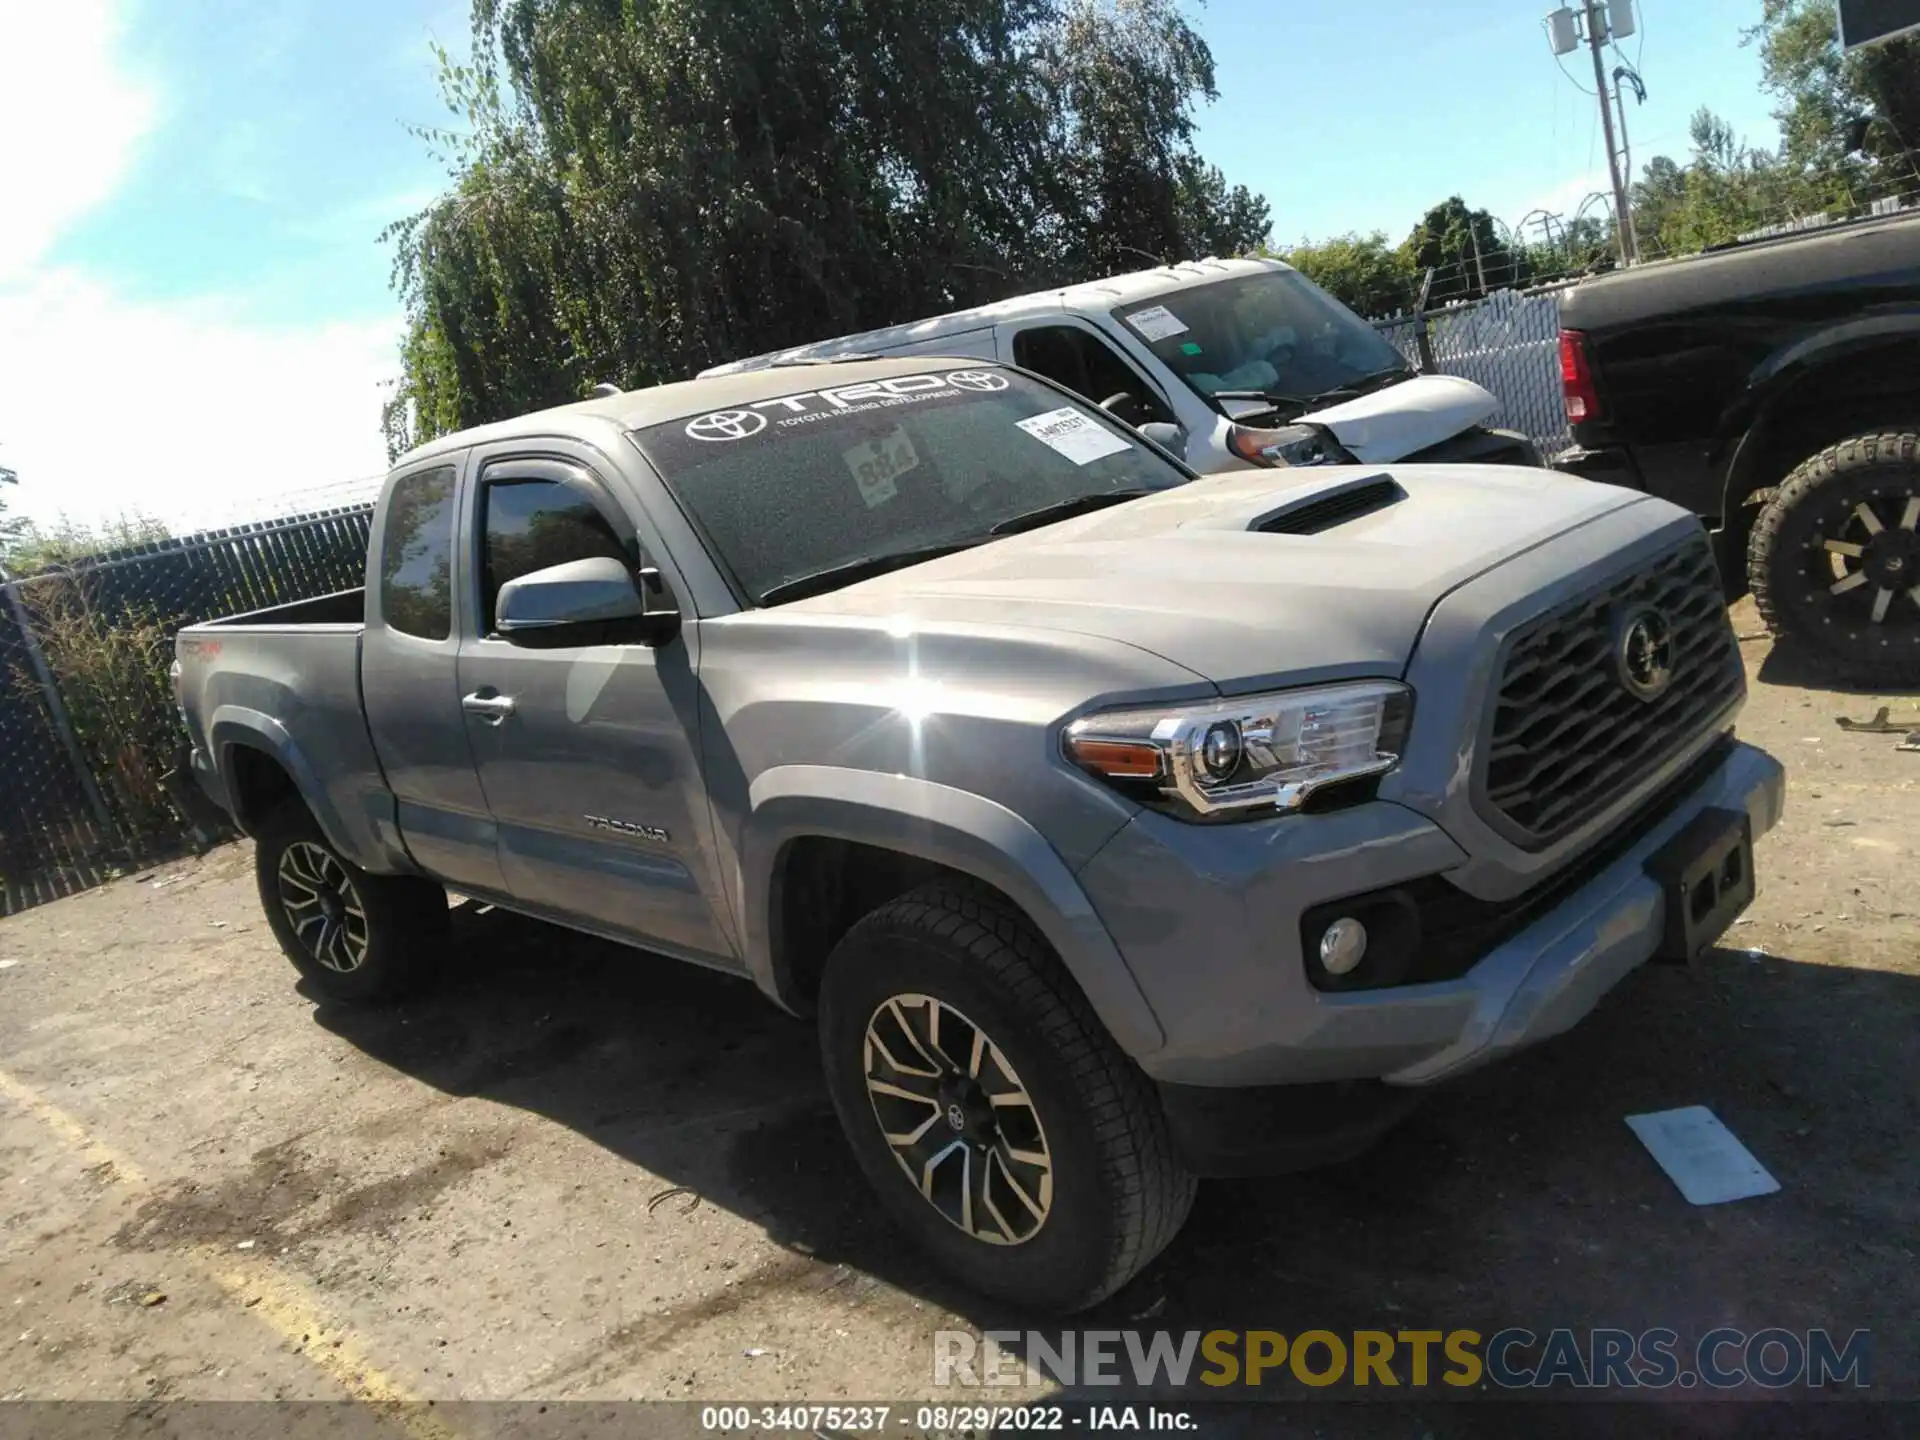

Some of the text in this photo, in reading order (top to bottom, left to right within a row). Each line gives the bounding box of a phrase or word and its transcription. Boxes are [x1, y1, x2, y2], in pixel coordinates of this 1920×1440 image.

[751, 375, 948, 411] TRD
[777, 388, 963, 428] TOYOTA RACING DEVELOPMENT
[583, 814, 668, 843] TACOMA
